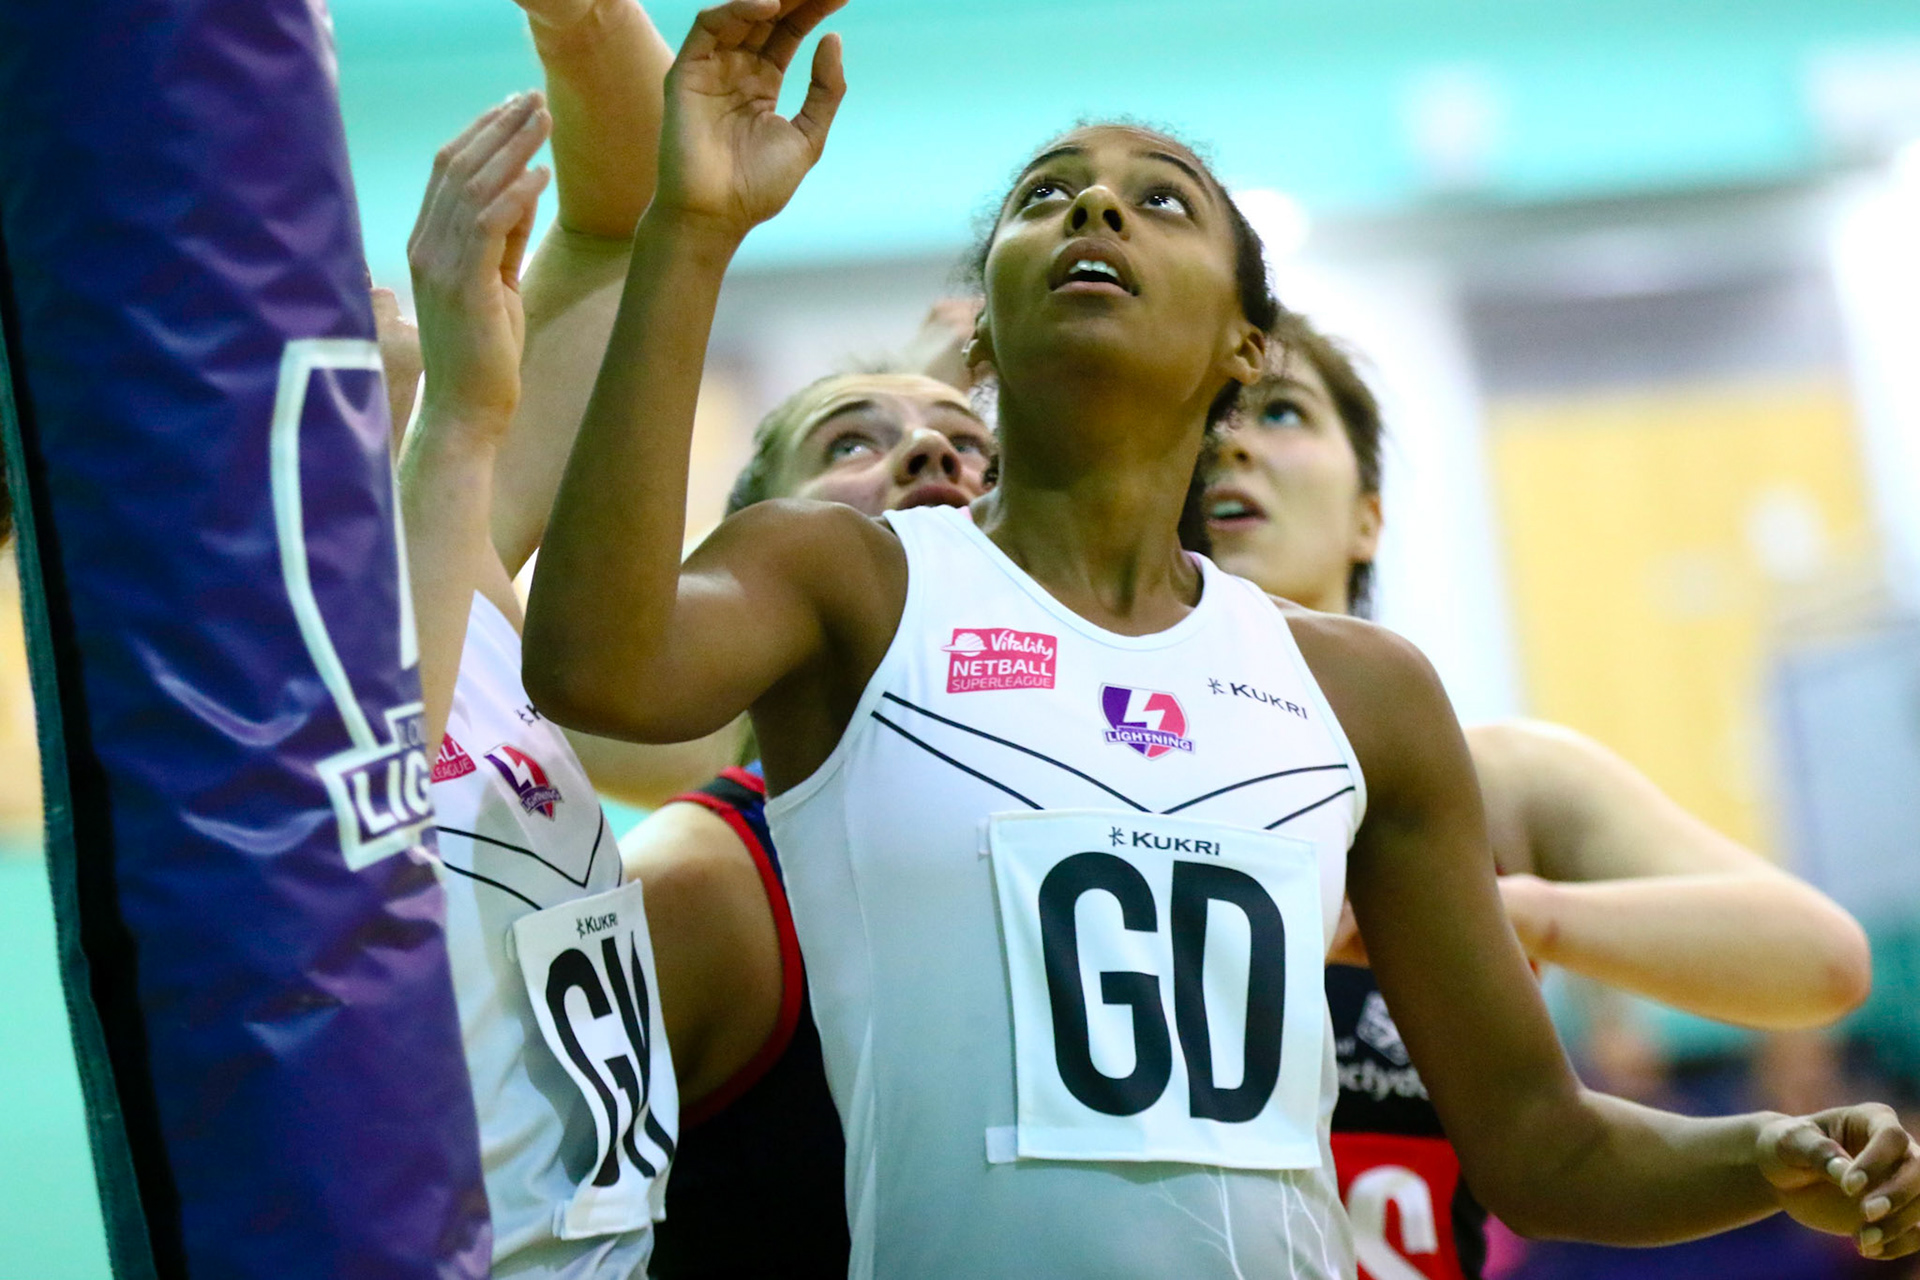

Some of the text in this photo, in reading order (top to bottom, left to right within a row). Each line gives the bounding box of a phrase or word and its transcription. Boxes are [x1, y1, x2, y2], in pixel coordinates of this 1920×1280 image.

[990, 630, 1054, 661] Vitality
[953, 659, 1053, 677] NETBALL
[951, 675, 1052, 691] SUPERLEAGUE
[1230, 682, 1308, 720] KUKRI
[1106, 731, 1191, 751] LIGHTNING
[1132, 830, 1221, 856] KUKRI
[1038, 851, 1286, 1124] GD
[545, 931, 675, 1188] GK
